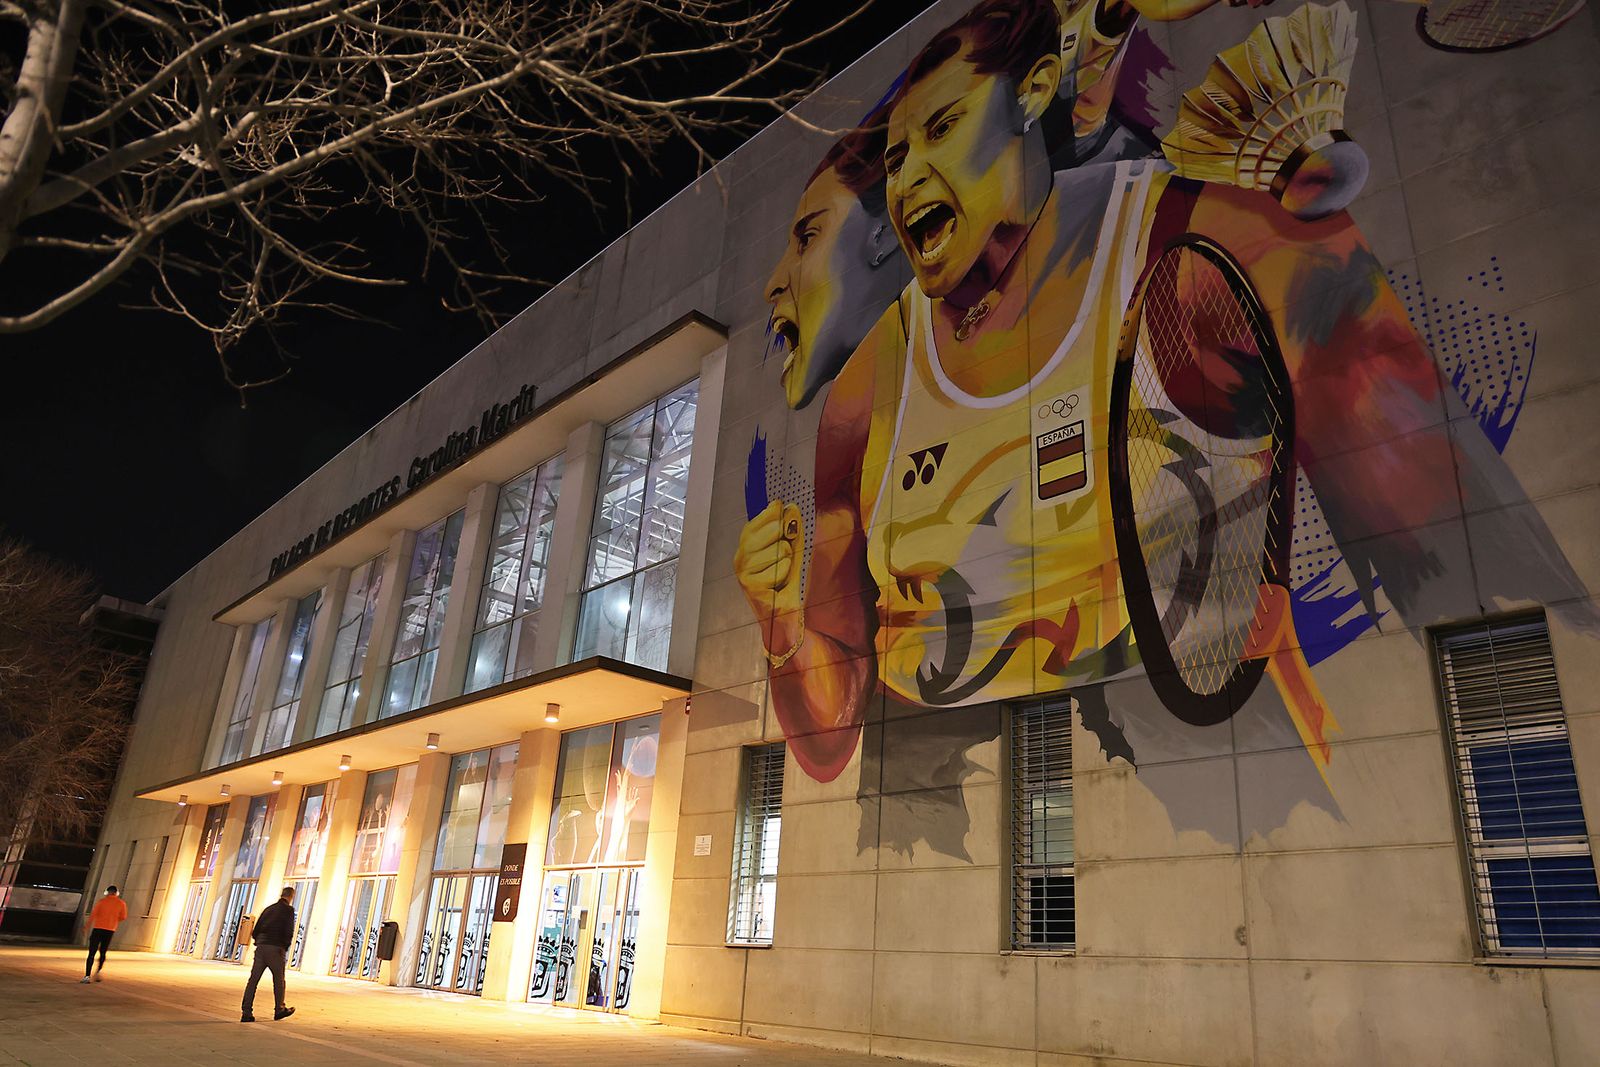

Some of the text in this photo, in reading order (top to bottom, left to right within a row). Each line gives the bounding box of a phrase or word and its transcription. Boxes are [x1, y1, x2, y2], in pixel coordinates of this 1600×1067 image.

[1042, 427, 1076, 446] ESPAÑA
[331, 475, 401, 539] DEPORTES
[407, 425, 479, 488] Carolina
[504, 864, 519, 872] DONDE
